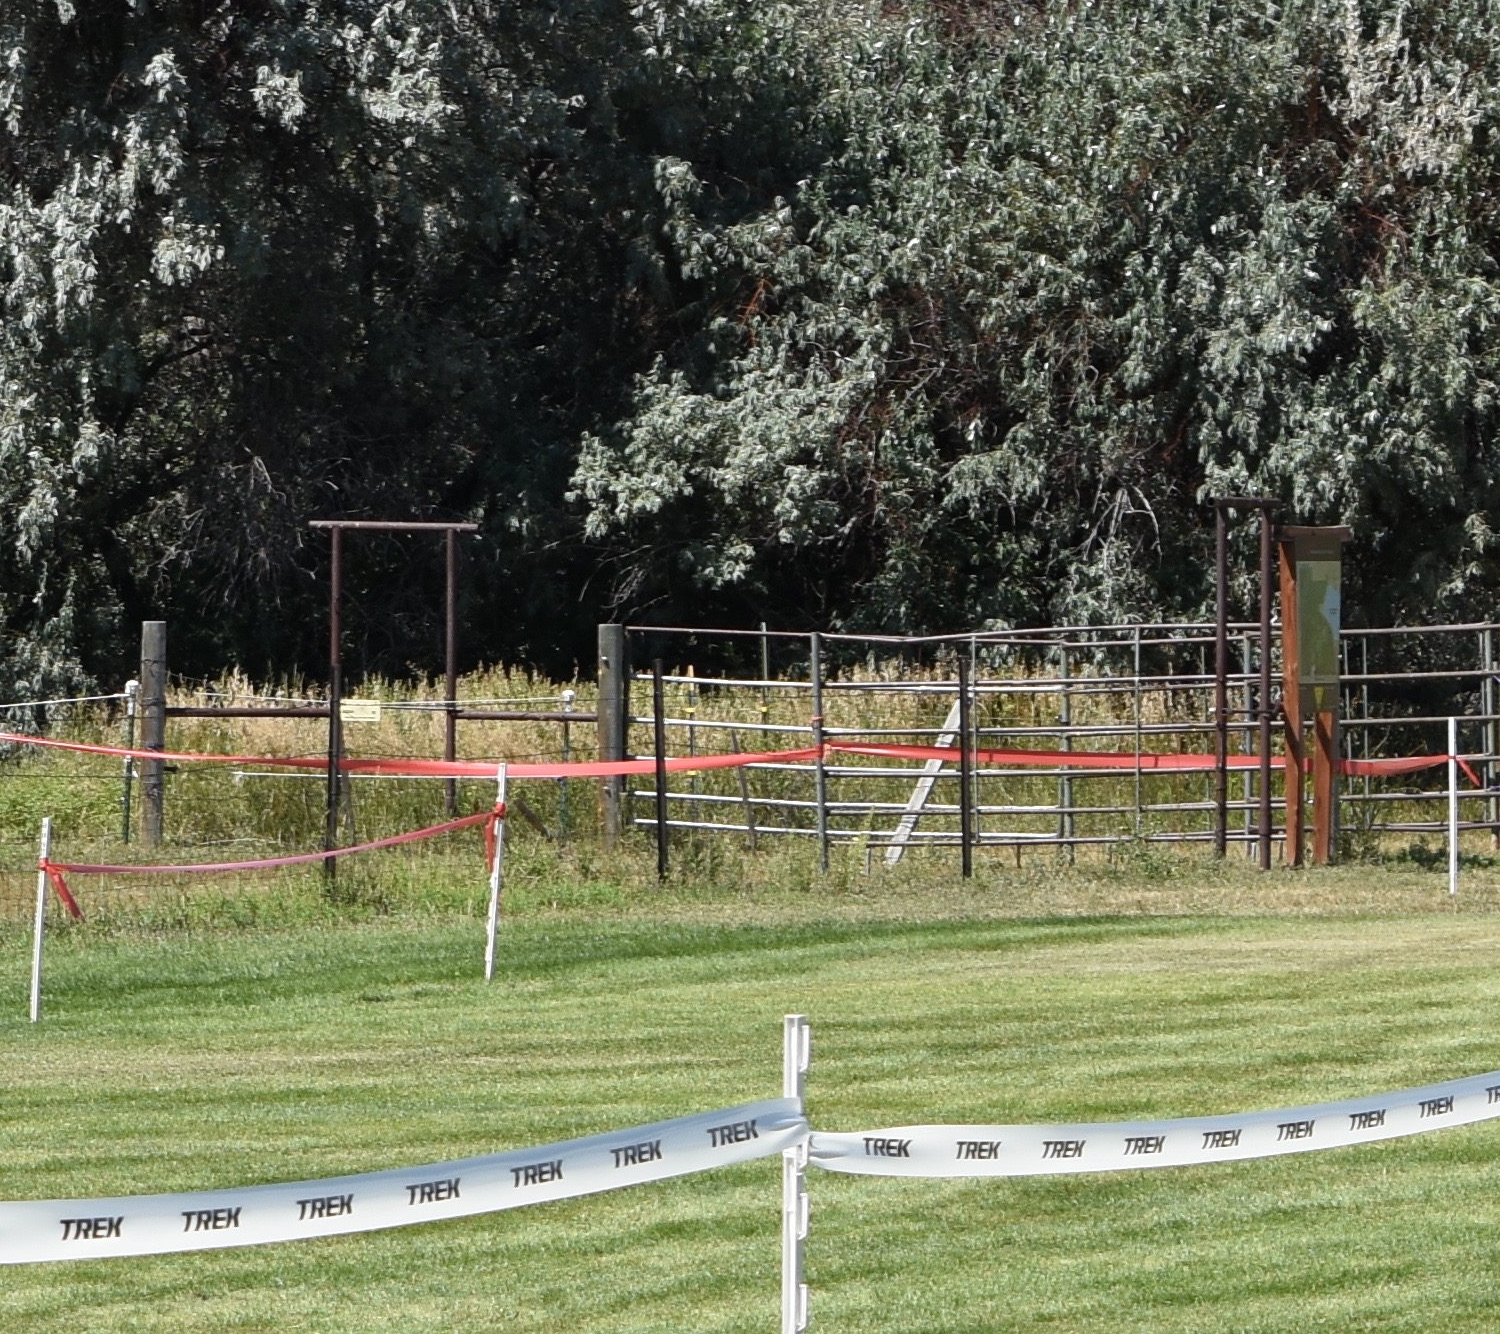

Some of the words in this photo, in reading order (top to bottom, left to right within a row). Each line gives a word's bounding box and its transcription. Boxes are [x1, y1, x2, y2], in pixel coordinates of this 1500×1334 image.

[862, 1137, 912, 1158] TREK
[956, 1141, 1002, 1160] TREK
[1042, 1139, 1087, 1159] TREK
[1123, 1135, 1166, 1156] TREK
[1202, 1128, 1243, 1150] TREK
[1276, 1119, 1316, 1141] TREK
[1348, 1108, 1387, 1131] TREK
[1417, 1094, 1455, 1119] TREK
[59, 1215, 125, 1241] TREK
[180, 1206, 243, 1233] TREK
[297, 1194, 355, 1221] TREK
[406, 1178, 462, 1206] TREK
[510, 1160, 564, 1188] TREK
[610, 1140, 663, 1169] TREK
[706, 1118, 760, 1148] TREK
